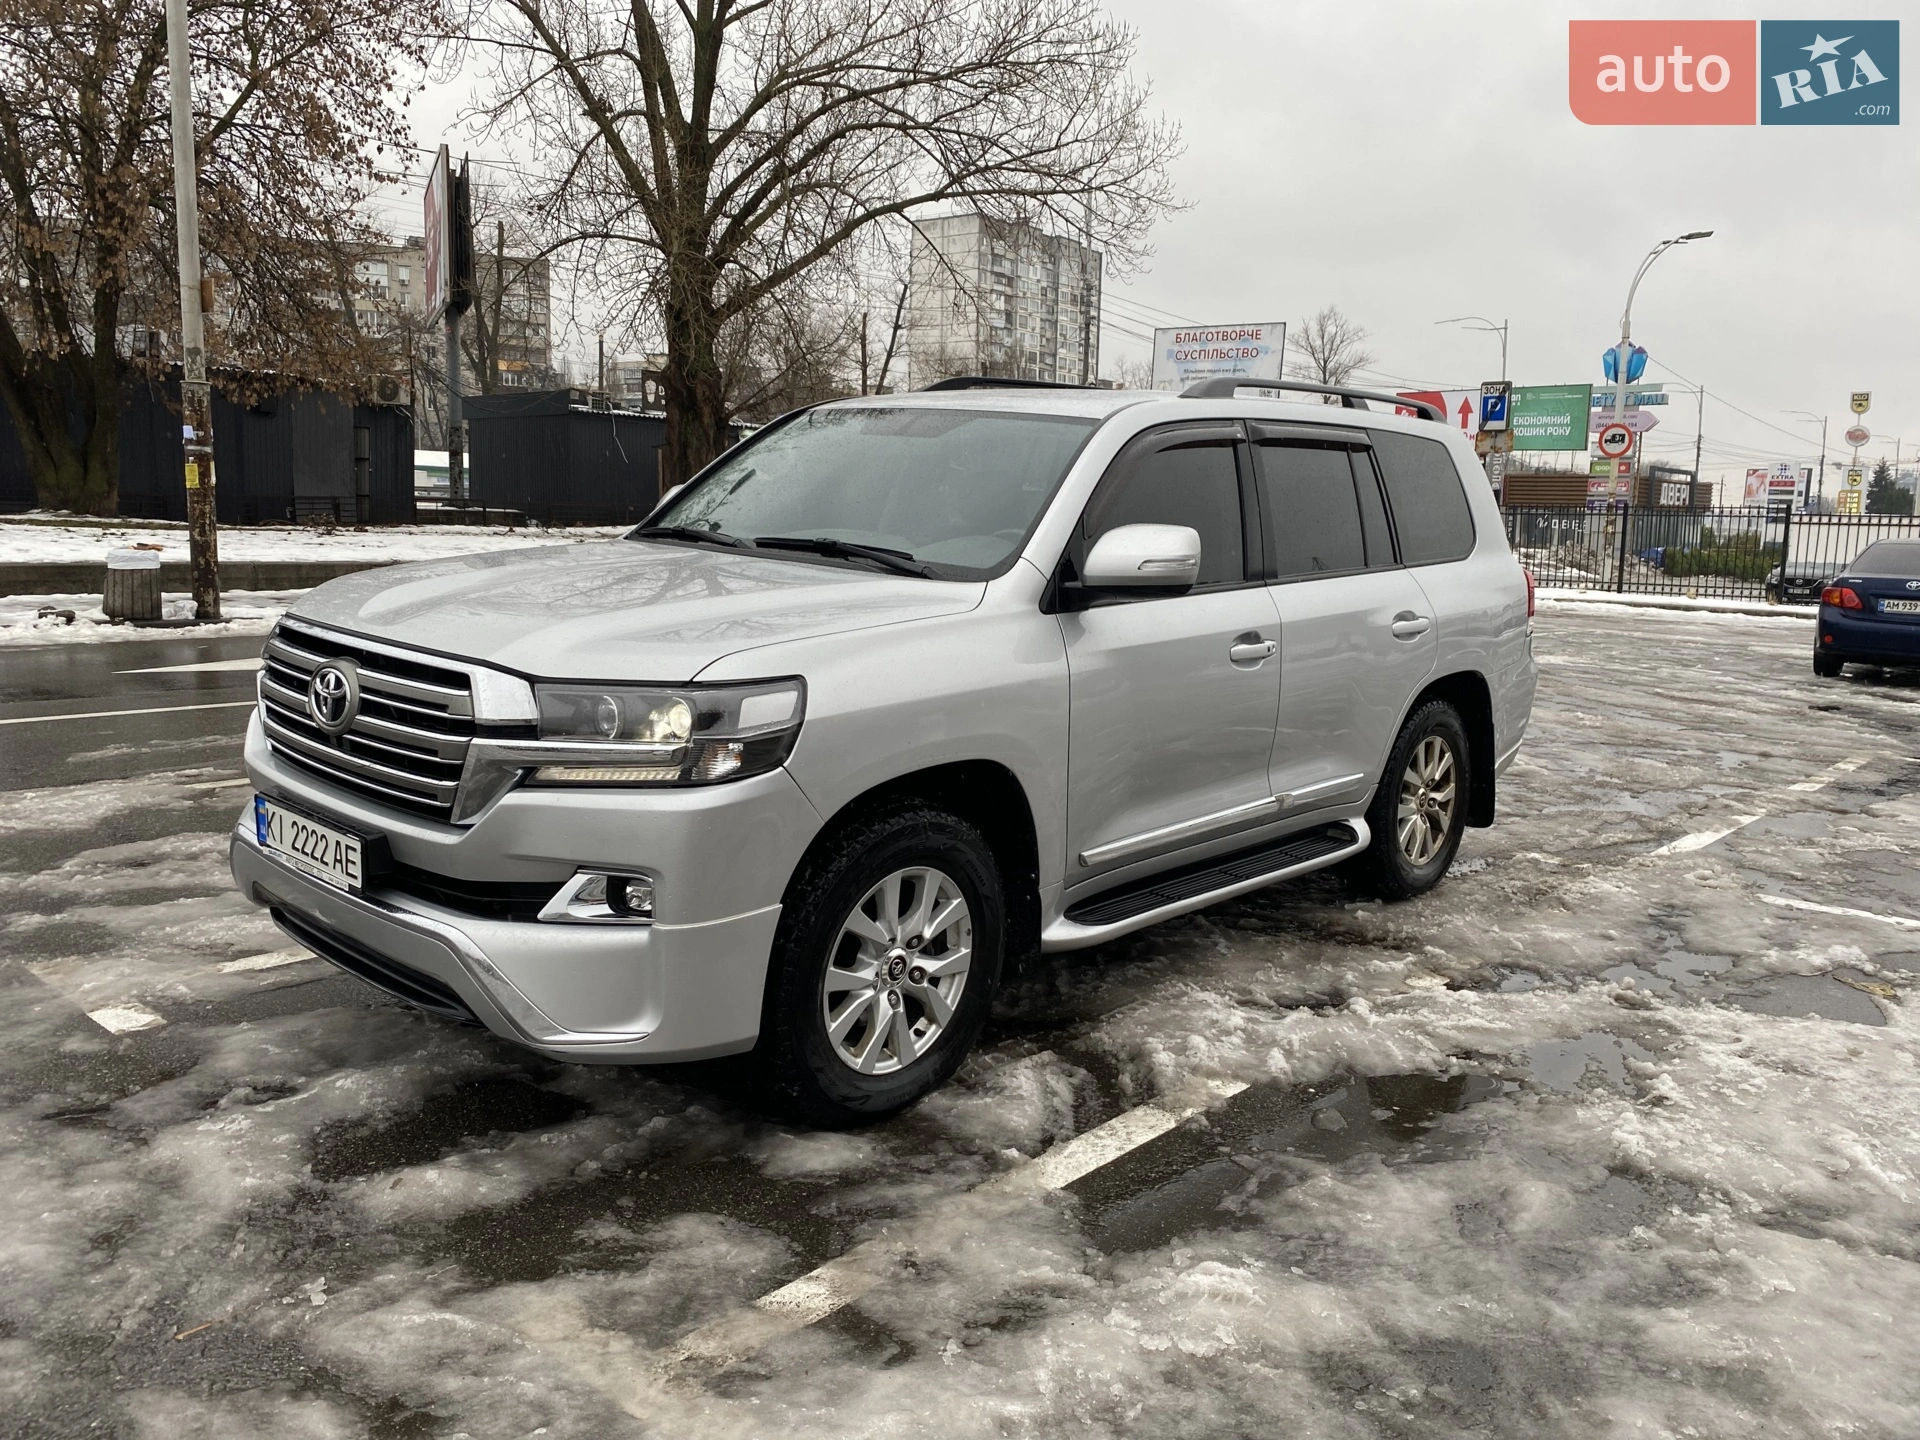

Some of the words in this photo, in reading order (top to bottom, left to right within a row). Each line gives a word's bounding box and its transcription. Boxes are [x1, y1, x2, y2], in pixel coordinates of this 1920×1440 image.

[1175, 329, 1262, 344] БЛАГОТВОРЧЕ
[1175, 347, 1259, 361] СУСПІЛЬСТВО
[1483, 386, 1507, 395] ЗОНА
[1513, 413, 1571, 425] ЕКОНОМНИЙ
[1513, 427, 1545, 437] КОШИК
[1547, 426, 1571, 436] РОКУ
[1660, 482, 1690, 506] ДВЕРІ
[1885, 602, 1900, 610] AM
[1901, 602, 1920, 611] 939
[266, 807, 283, 845] KI
[291, 820, 330, 867] 2222
[333, 839, 358, 880] AE
